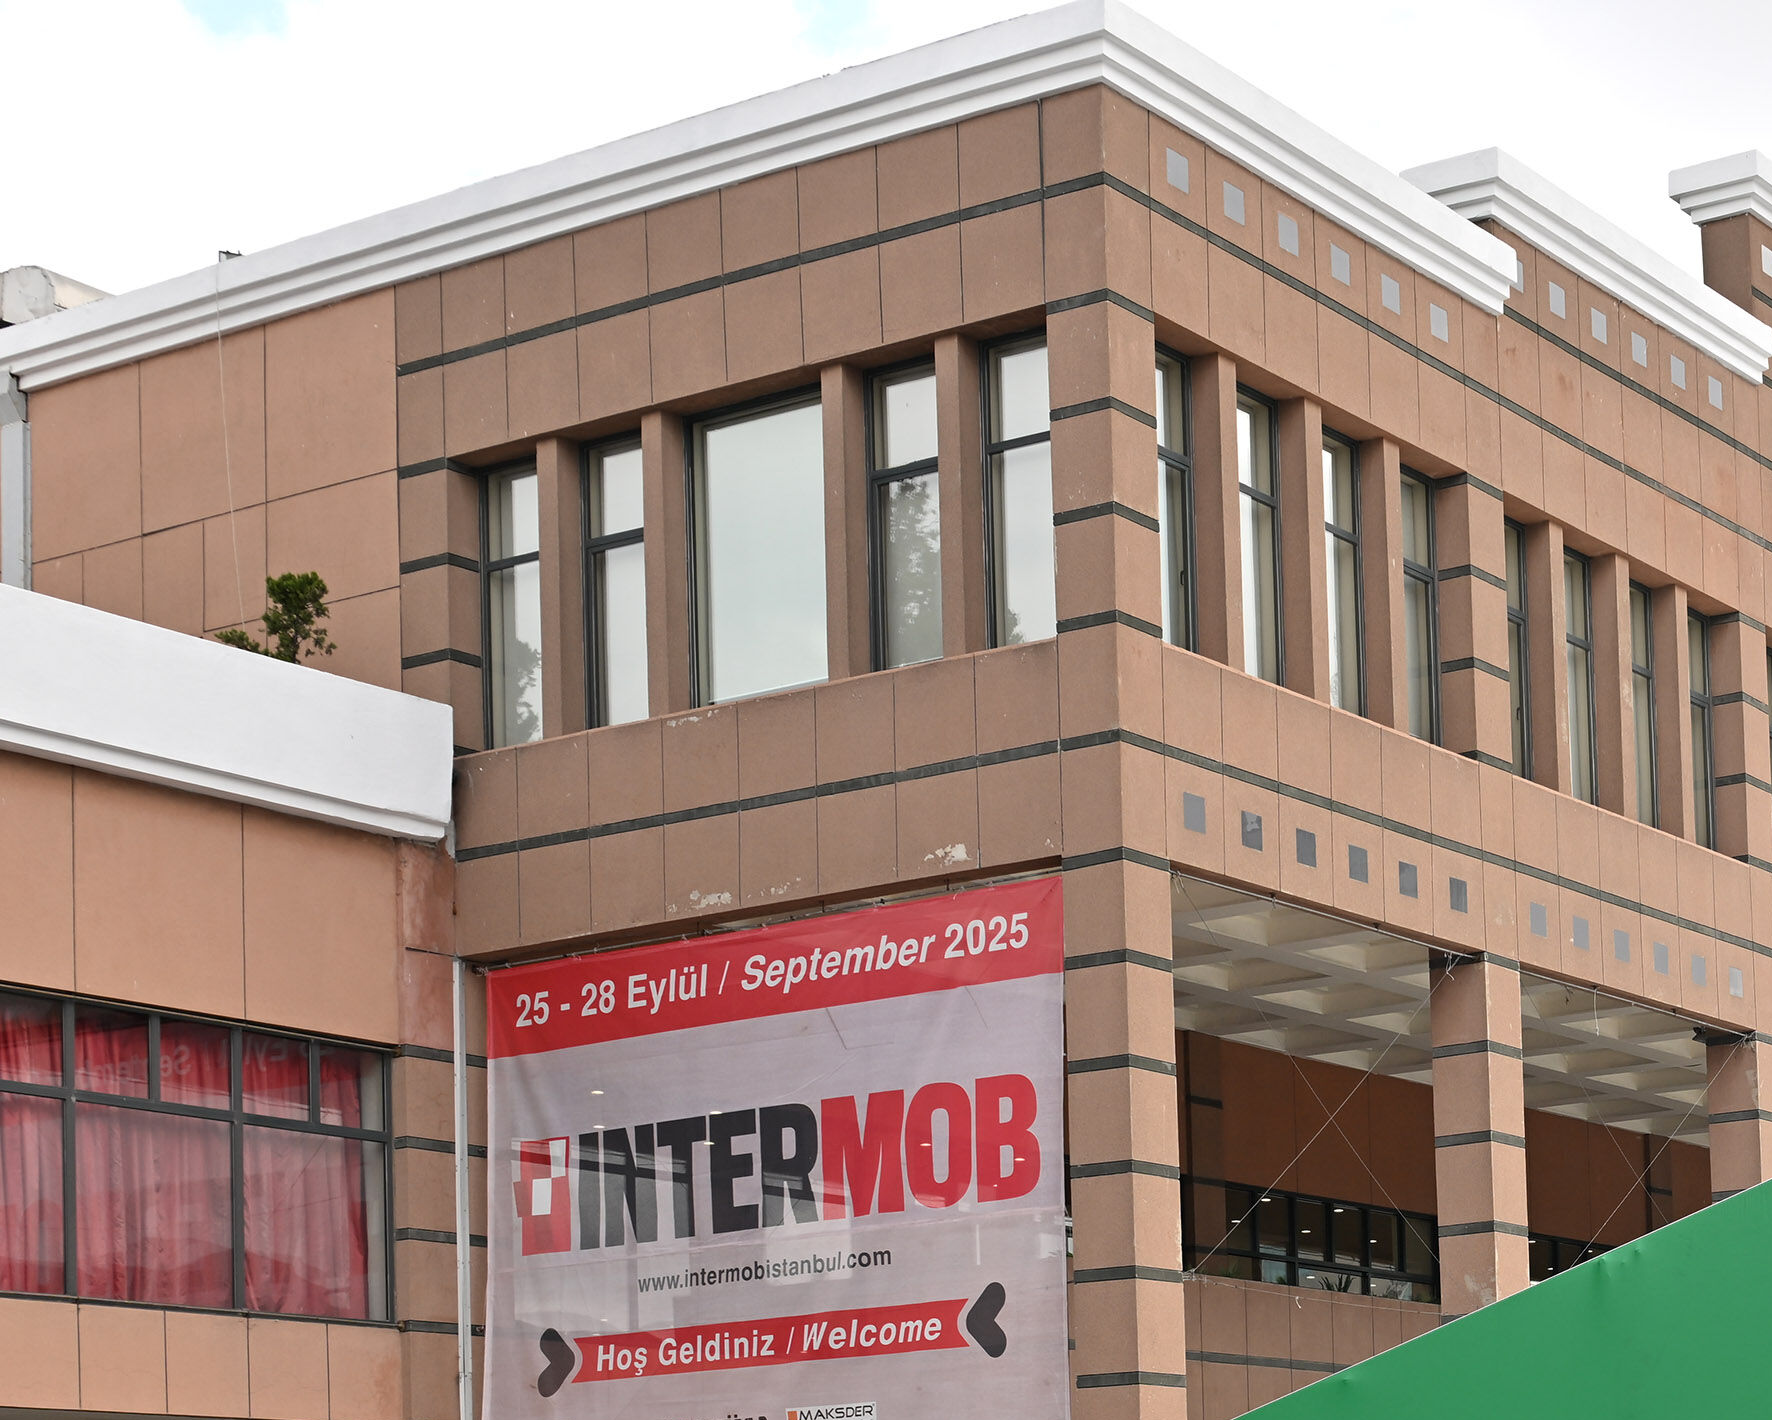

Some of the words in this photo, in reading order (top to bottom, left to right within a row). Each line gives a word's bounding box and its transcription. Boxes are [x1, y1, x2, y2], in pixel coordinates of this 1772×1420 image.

[515, 990, 550, 1028] 25
[581, 979, 616, 1016] 28
[627, 963, 708, 1014] Eylül
[741, 933, 935, 994] September
[944, 912, 1029, 959] 2025
[578, 1073, 1042, 1251] INTERMOB
[638, 1249, 892, 1294] www.intermobistanbul.com
[596, 1343, 648, 1376] Hoş
[658, 1328, 776, 1365] Geldiniz
[803, 1313, 942, 1352] Welcome
[799, 1405, 873, 1420] MAKSDER
